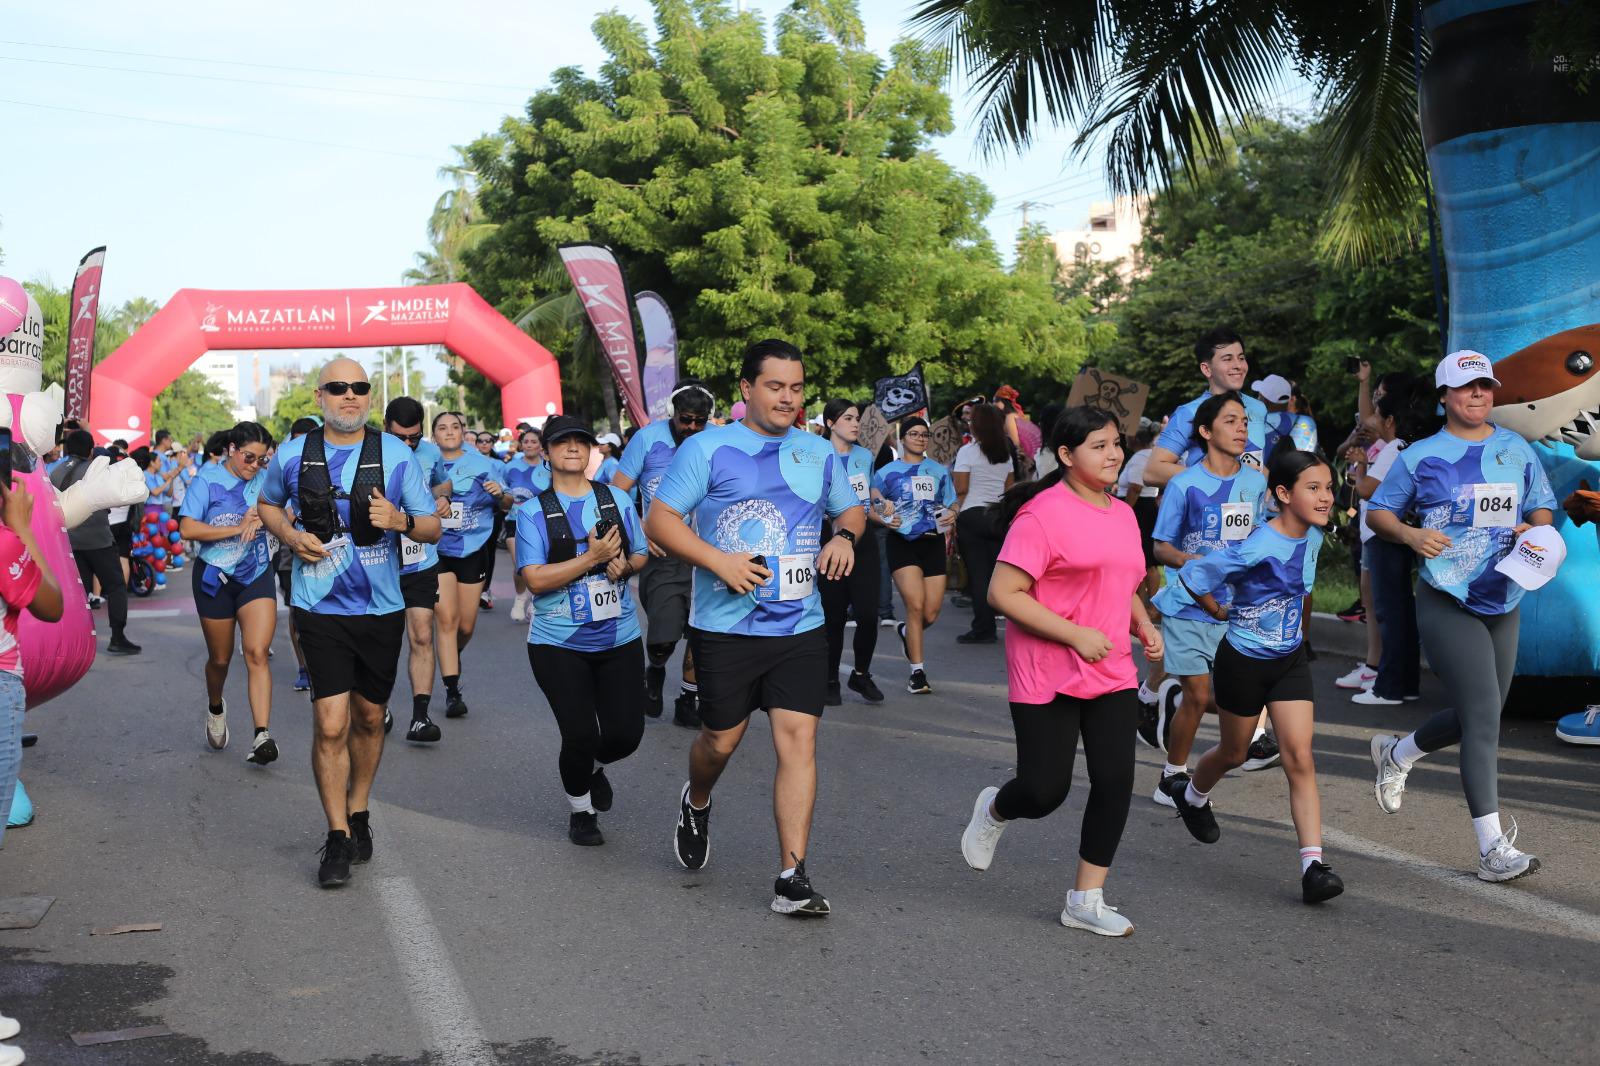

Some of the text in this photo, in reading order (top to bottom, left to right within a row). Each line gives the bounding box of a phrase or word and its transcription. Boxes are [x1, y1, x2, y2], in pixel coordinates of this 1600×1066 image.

[391, 298, 449, 313] IMDEM
[226, 305, 336, 325] MAZATLÁN
[915, 482, 933, 492] 063
[1479, 496, 1513, 512] 084
[1225, 513, 1250, 527] 066
[405, 543, 423, 556] 087
[785, 567, 813, 585] 108
[594, 590, 618, 607] 078
